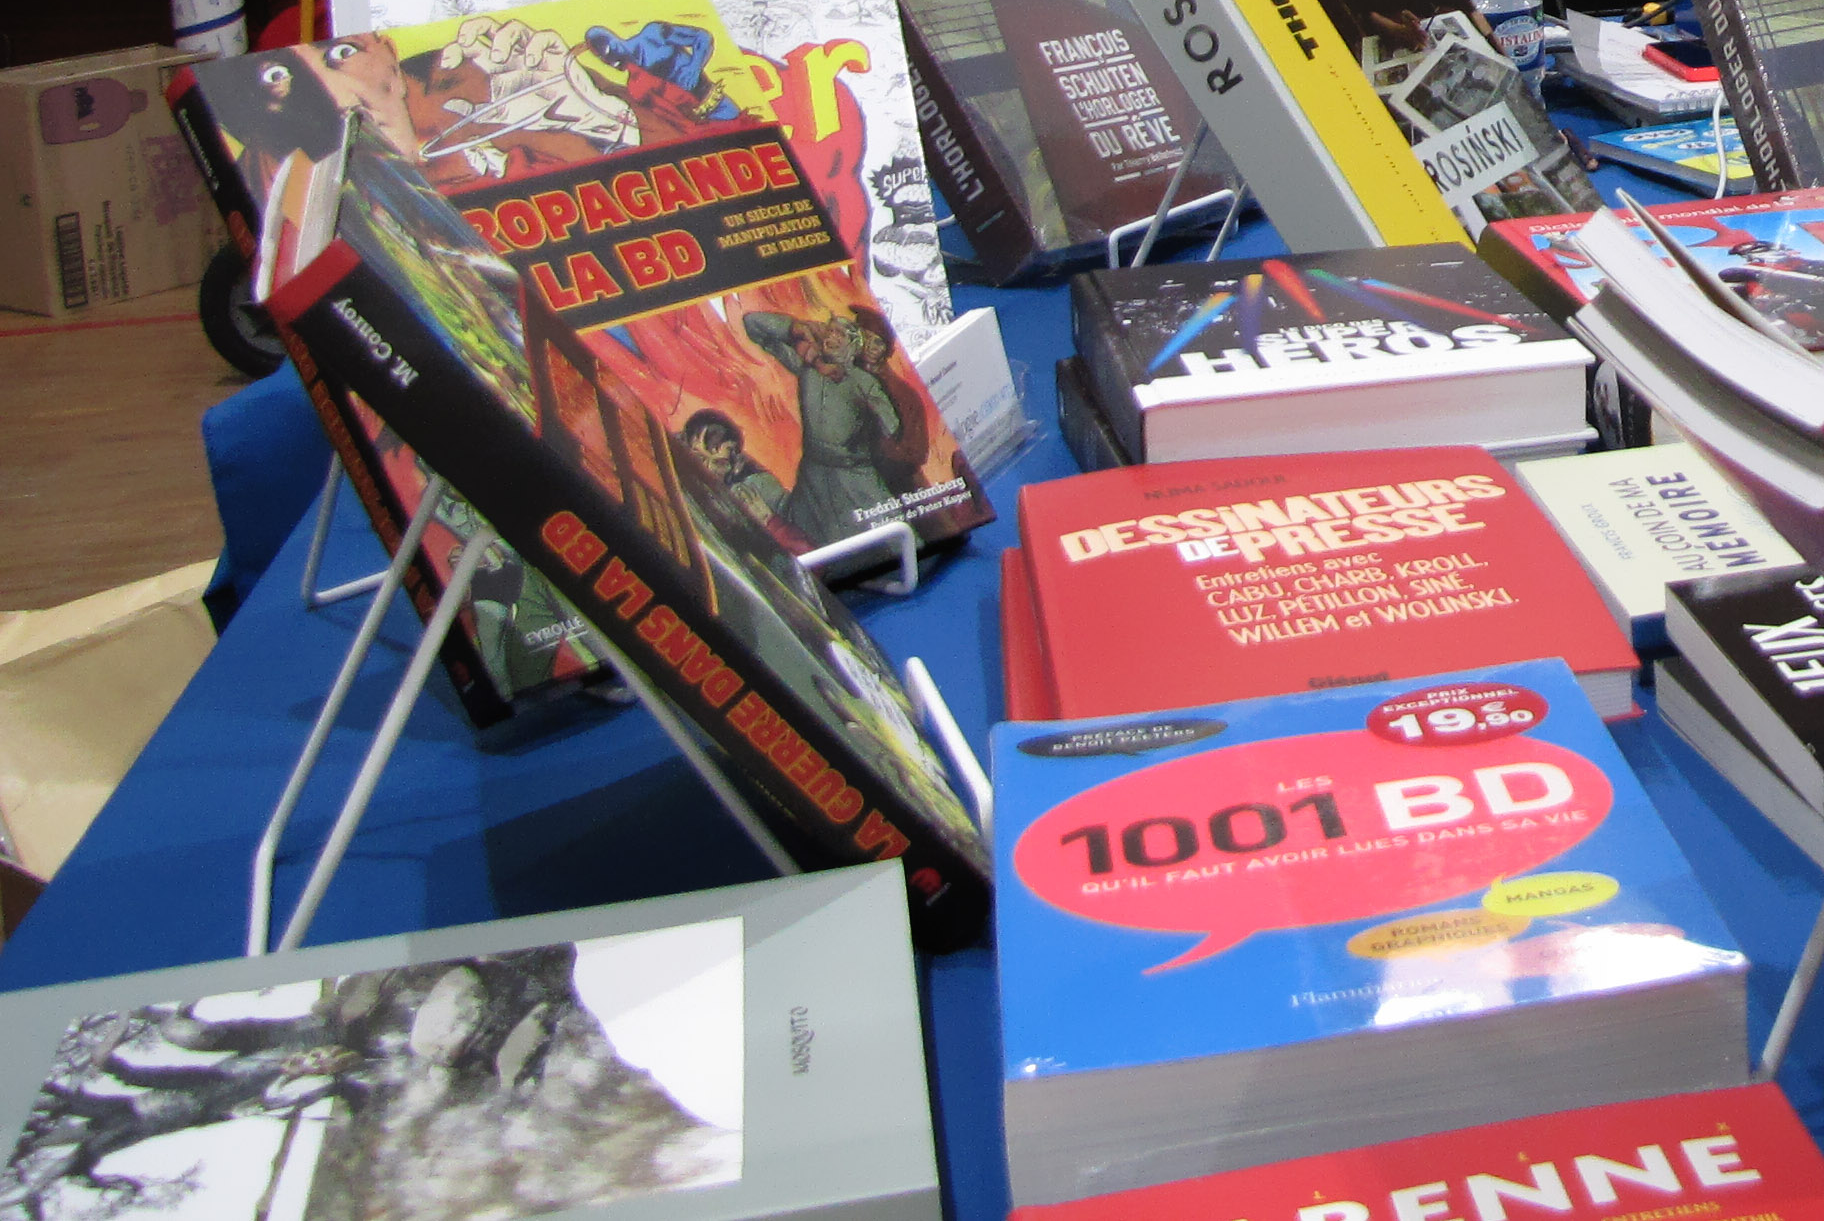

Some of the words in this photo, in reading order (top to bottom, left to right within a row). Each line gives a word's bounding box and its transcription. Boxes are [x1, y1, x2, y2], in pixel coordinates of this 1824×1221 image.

[1039, 28, 1131, 69] FRANÇOIS
[1058, 61, 1151, 101] SCHUITEN
[1072, 86, 1160, 123] L'HORLOGER
[1087, 127, 1122, 159] DU
[1125, 112, 1181, 150] RÊVE
[462, 141, 799, 255] ROPAGANDE
[723, 213, 746, 228] UN
[746, 201, 792, 223] SIÈCLE
[794, 197, 814, 213] DE
[1659, 204, 1738, 222] mondial
[1743, 201, 1768, 211] de
[718, 215, 823, 249] MANIPULATION
[758, 243, 779, 258] EN
[780, 231, 832, 253] IMAGES
[530, 249, 624, 312] LA
[614, 229, 707, 290] BD
[330, 292, 396, 364] Conroy
[1254, 321, 1436, 347] SUPER
[386, 354, 420, 388] M.
[853, 498, 902, 523] Fredrik
[901, 476, 967, 506] Strömberg
[917, 500, 944, 515] Peter
[1607, 475, 1648, 501] MA
[1627, 500, 1662, 521] DE
[1646, 469, 1767, 568] MÉMOIRE
[540, 510, 608, 575] BD
[1178, 534, 1240, 565] DE
[1237, 504, 1487, 565] PRESSE
[1642, 518, 1693, 557] COIN
[1196, 560, 1323, 591] Entretiens
[1326, 550, 1385, 572] avec
[1207, 580, 1291, 608] CABU,
[1294, 565, 1396, 597] CHARB,
[1396, 553, 1490, 584] KROLL,
[1675, 551, 1713, 575] AU
[593, 556, 655, 621] LA
[1217, 601, 1277, 628] LUZ,
[1284, 581, 1409, 620] PÉTILLON,
[525, 616, 585, 646] EYROLLE
[1229, 614, 1342, 647] WILLEM
[1346, 612, 1374, 631] et
[1378, 587, 1520, 626] WOLINSKI.
[636, 605, 745, 708] DANS
[1382, 687, 1520, 714] EXCEPTIONNEL
[1427, 687, 1469, 701] PRIX
[726, 690, 865, 824] GUERRE
[1277, 774, 1333, 794] LES
[854, 808, 911, 860] LA
[1060, 792, 1349, 877] 1001
[1373, 760, 1576, 833] BD
[1081, 874, 1155, 895] QU'IL
[1165, 861, 1235, 884] FAUT
[1246, 846, 1328, 872] AVOIR
[1337, 834, 1412, 858] LUES
[1416, 823, 1496, 845] DANS
[1501, 814, 1541, 831] SA
[1545, 807, 1590, 826] VIE
[1505, 880, 1597, 905] MANGAS
[787, 1005, 814, 1078] MOSQUITO
